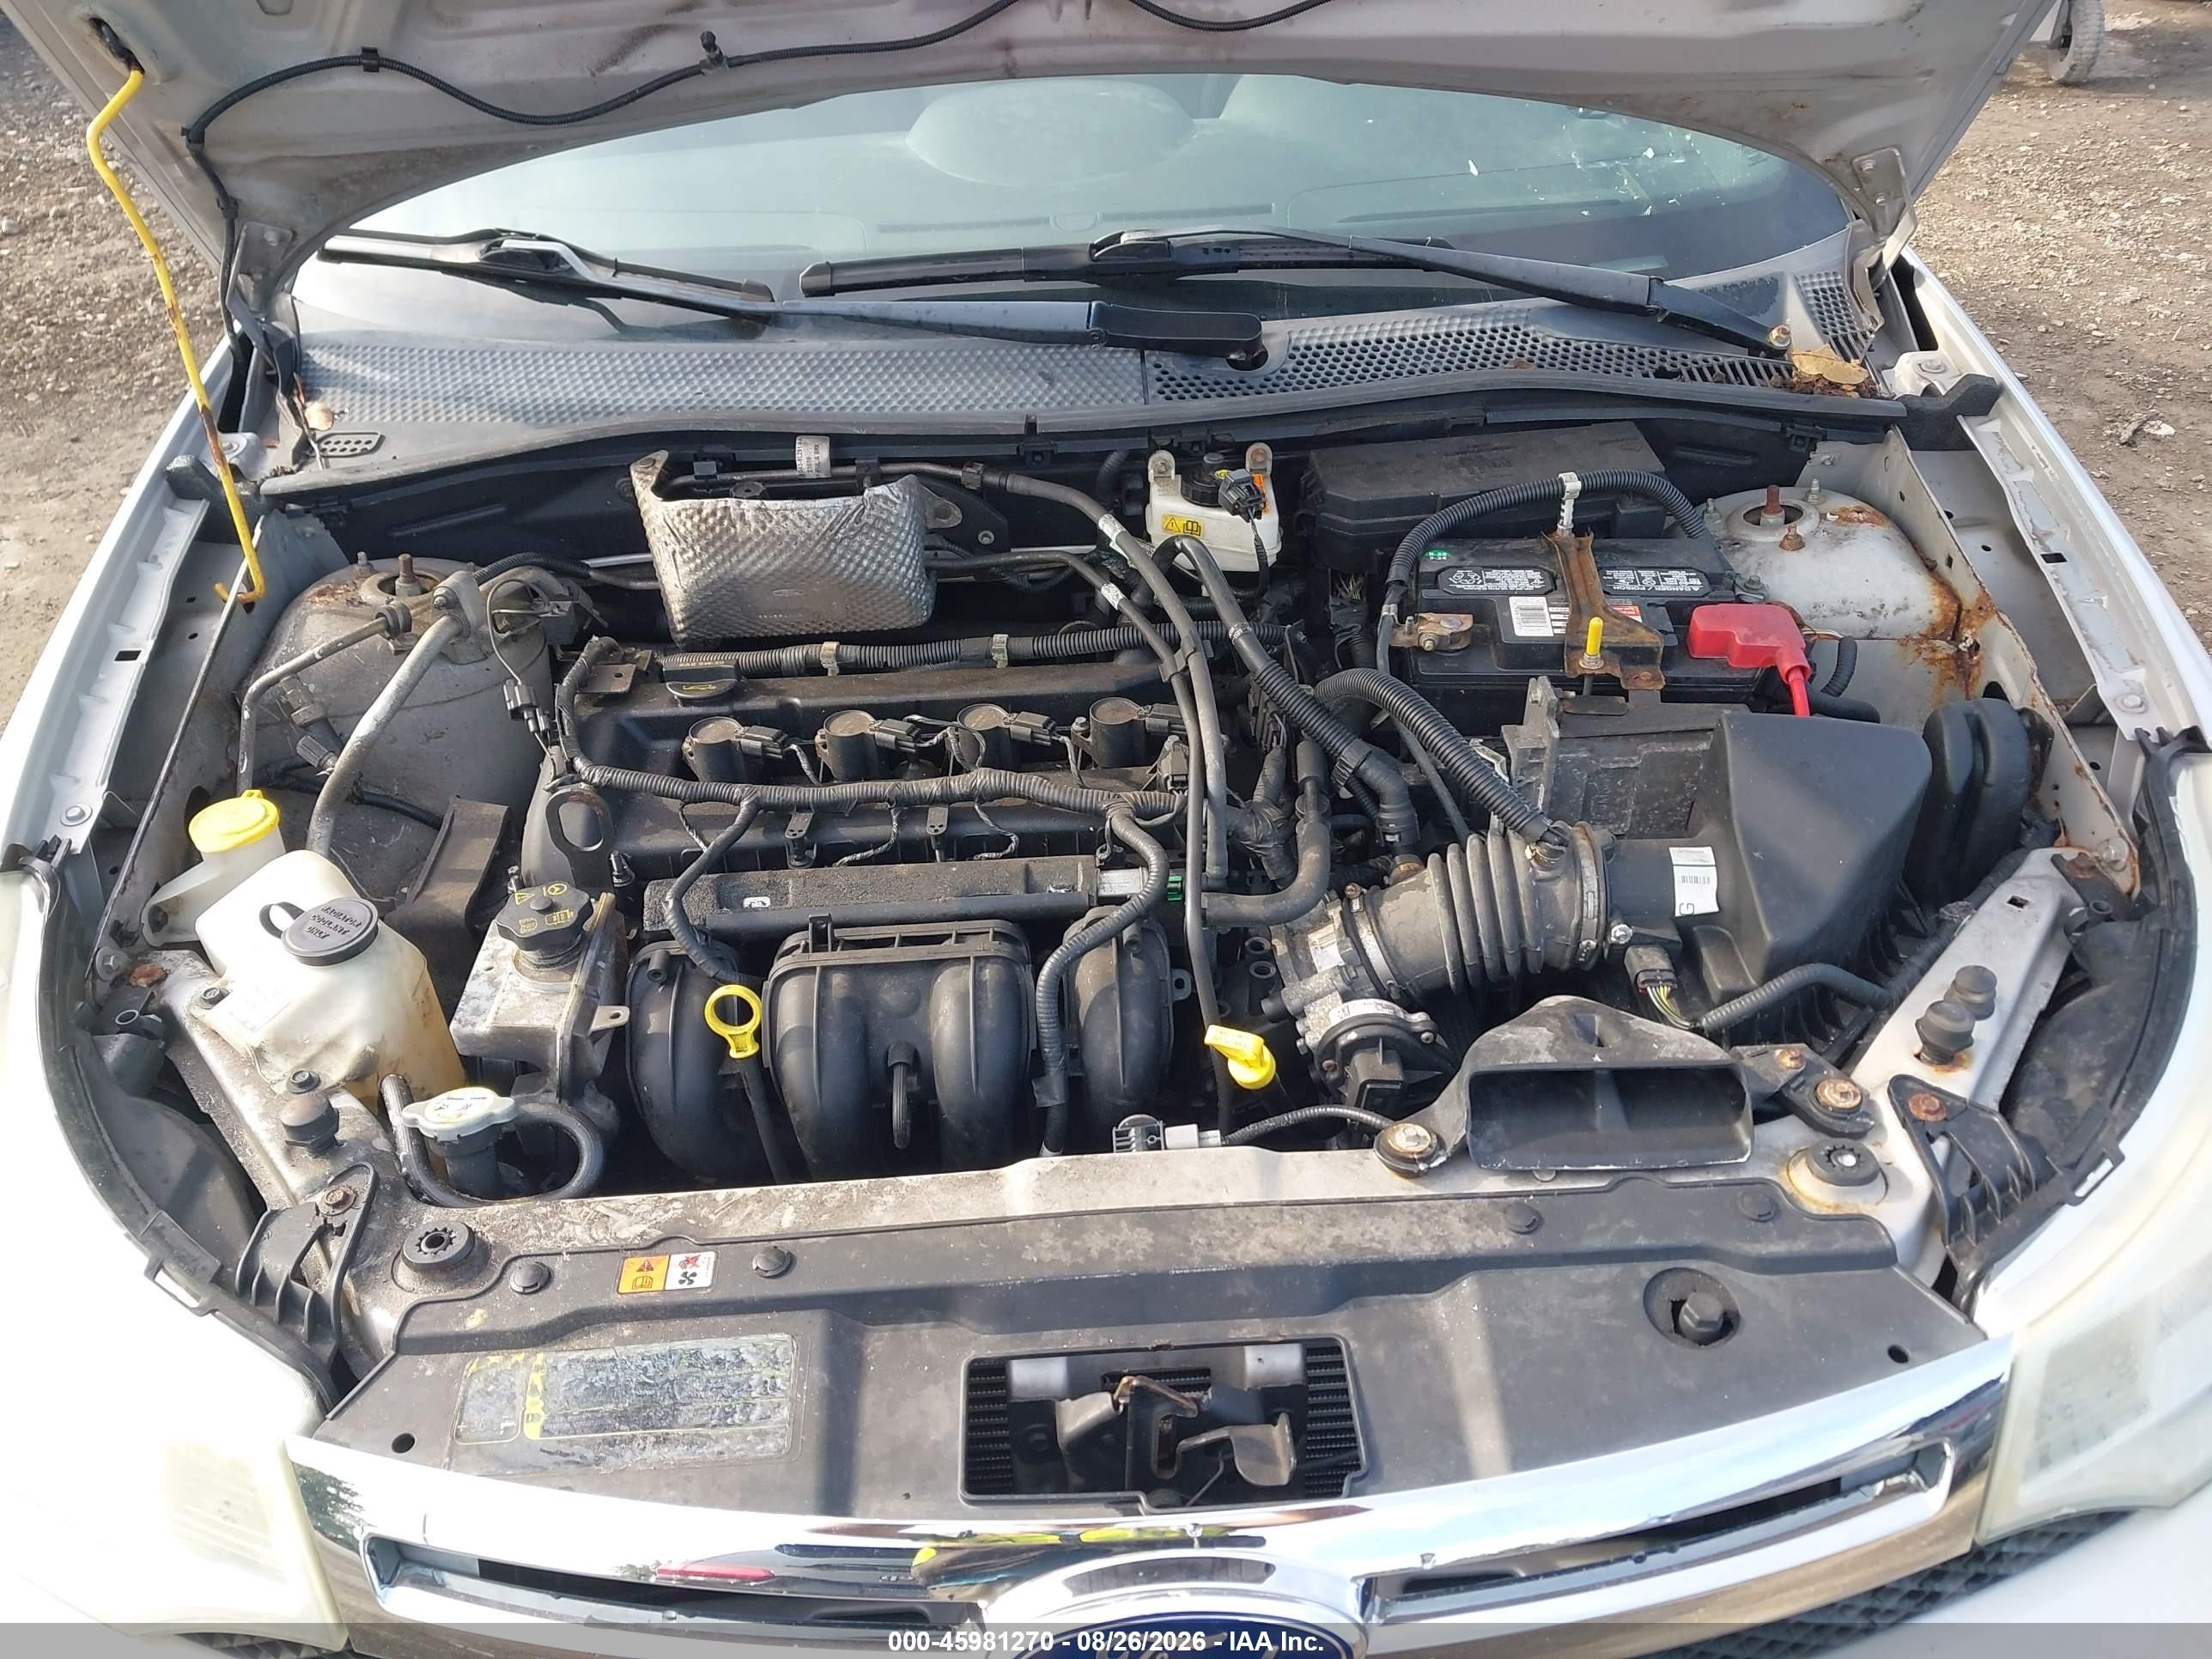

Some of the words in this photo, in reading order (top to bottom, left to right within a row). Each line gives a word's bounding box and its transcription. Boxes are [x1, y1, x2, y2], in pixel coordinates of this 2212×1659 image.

[321, 907, 362, 927] RADIATOR
[1679, 902, 1695, 916] G
[306, 926, 331, 939] ONLY
[309, 914, 350, 935] COOLANT
